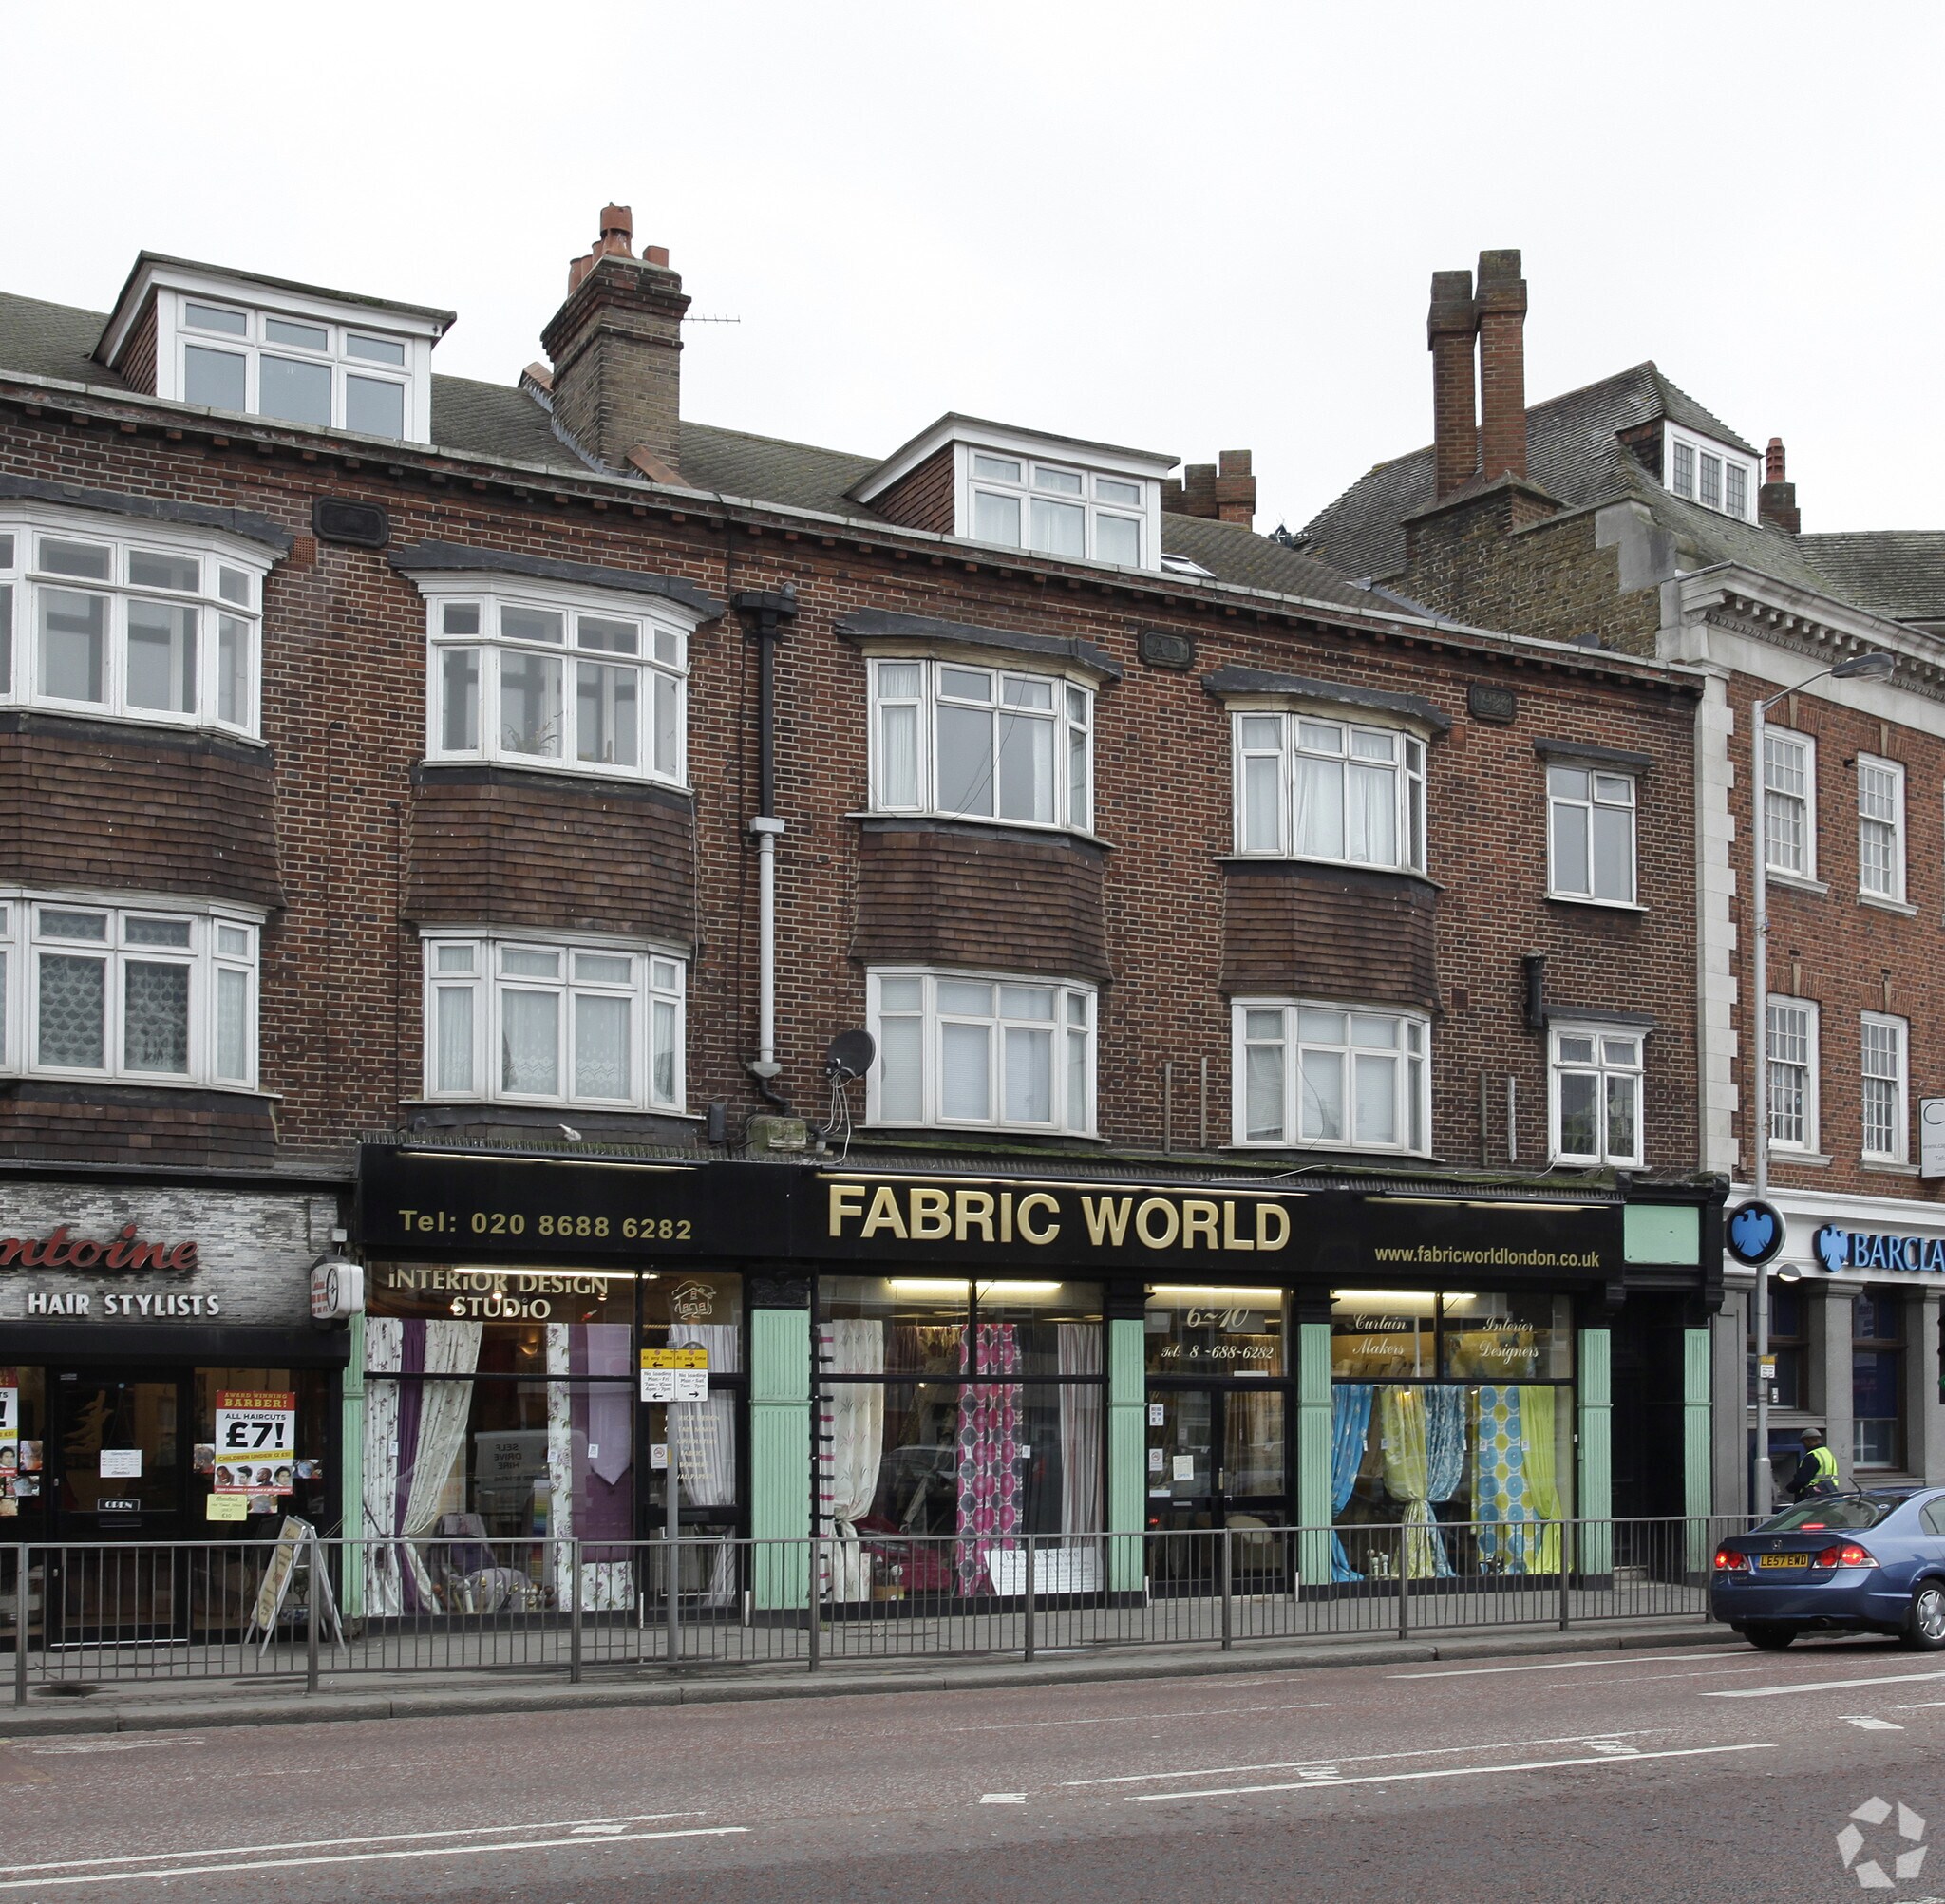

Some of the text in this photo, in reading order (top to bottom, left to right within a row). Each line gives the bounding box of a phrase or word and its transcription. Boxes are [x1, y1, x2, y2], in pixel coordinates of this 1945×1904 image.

[399, 1210, 691, 1239] Tel: 020 8688 6282
[829, 1184, 1290, 1251] FABRIC WORLD
[1375, 1245, 1599, 1268] www.fabricworldlondon.co.uk
[1849, 1233, 1945, 1272] BARCLA
[28, 1293, 219, 1316] HAIR STYLISTS
[1353, 1313, 1407, 1330] Curtain
[1482, 1315, 1534, 1332] Interior
[1352, 1338, 1405, 1355] Makers
[1479, 1340, 1539, 1365] Designers
[224, 1399, 287, 1408] BARBER!
[226, 1422, 285, 1448] £7!
[1761, 1555, 1785, 1566] LE57
